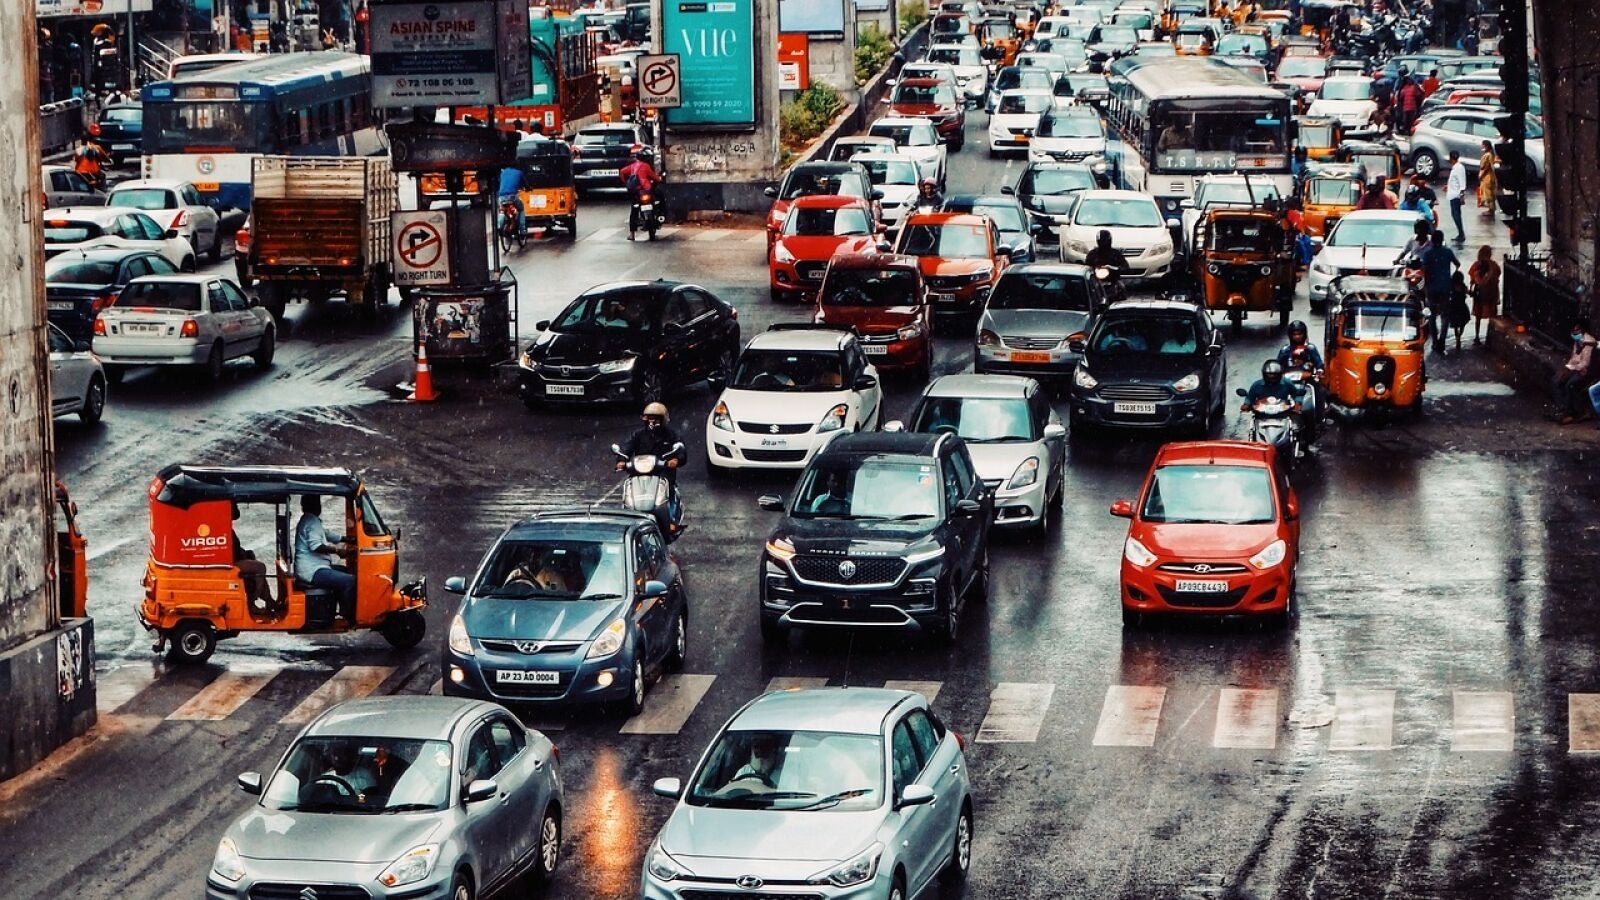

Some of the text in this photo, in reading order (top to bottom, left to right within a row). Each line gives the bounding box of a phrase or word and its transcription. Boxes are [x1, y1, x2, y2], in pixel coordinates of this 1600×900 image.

[390, 20, 475, 34] ASIAN SPINE
[398, 270, 447, 281] NO RIGHT TURN
[180, 536, 227, 547] VIRGO
[500, 672, 555, 682] AP 23 AD 0004
